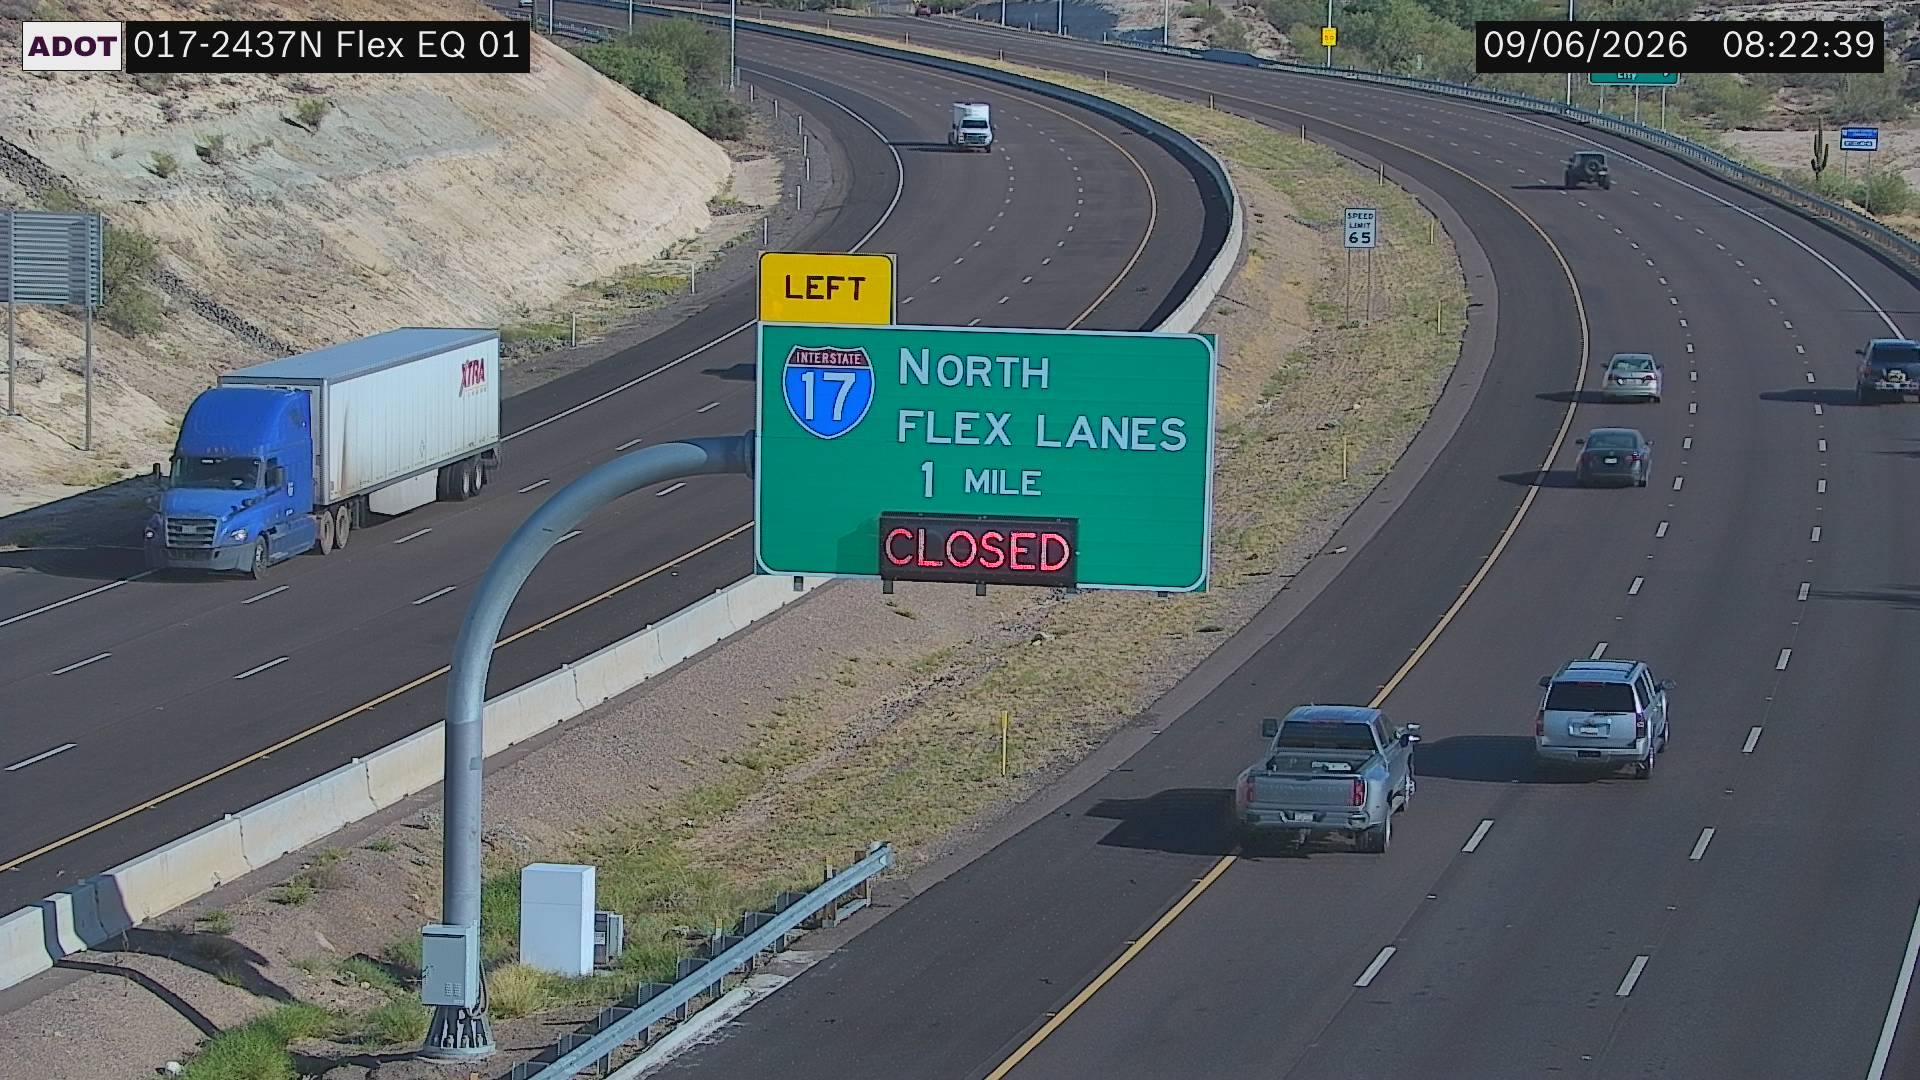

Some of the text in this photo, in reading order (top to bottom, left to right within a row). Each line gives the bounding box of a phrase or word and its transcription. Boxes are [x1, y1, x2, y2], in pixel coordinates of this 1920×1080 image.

[1349, 231, 1371, 244] 65
[785, 275, 866, 300] LEFT
[796, 352, 861, 365] INTERSTATE
[900, 348, 1050, 389] NORTH
[802, 371, 857, 421] 17
[898, 410, 1187, 452] FLEX LANES
[921, 461, 1042, 498] 1 MILE
[884, 528, 1071, 571] CLOSED
